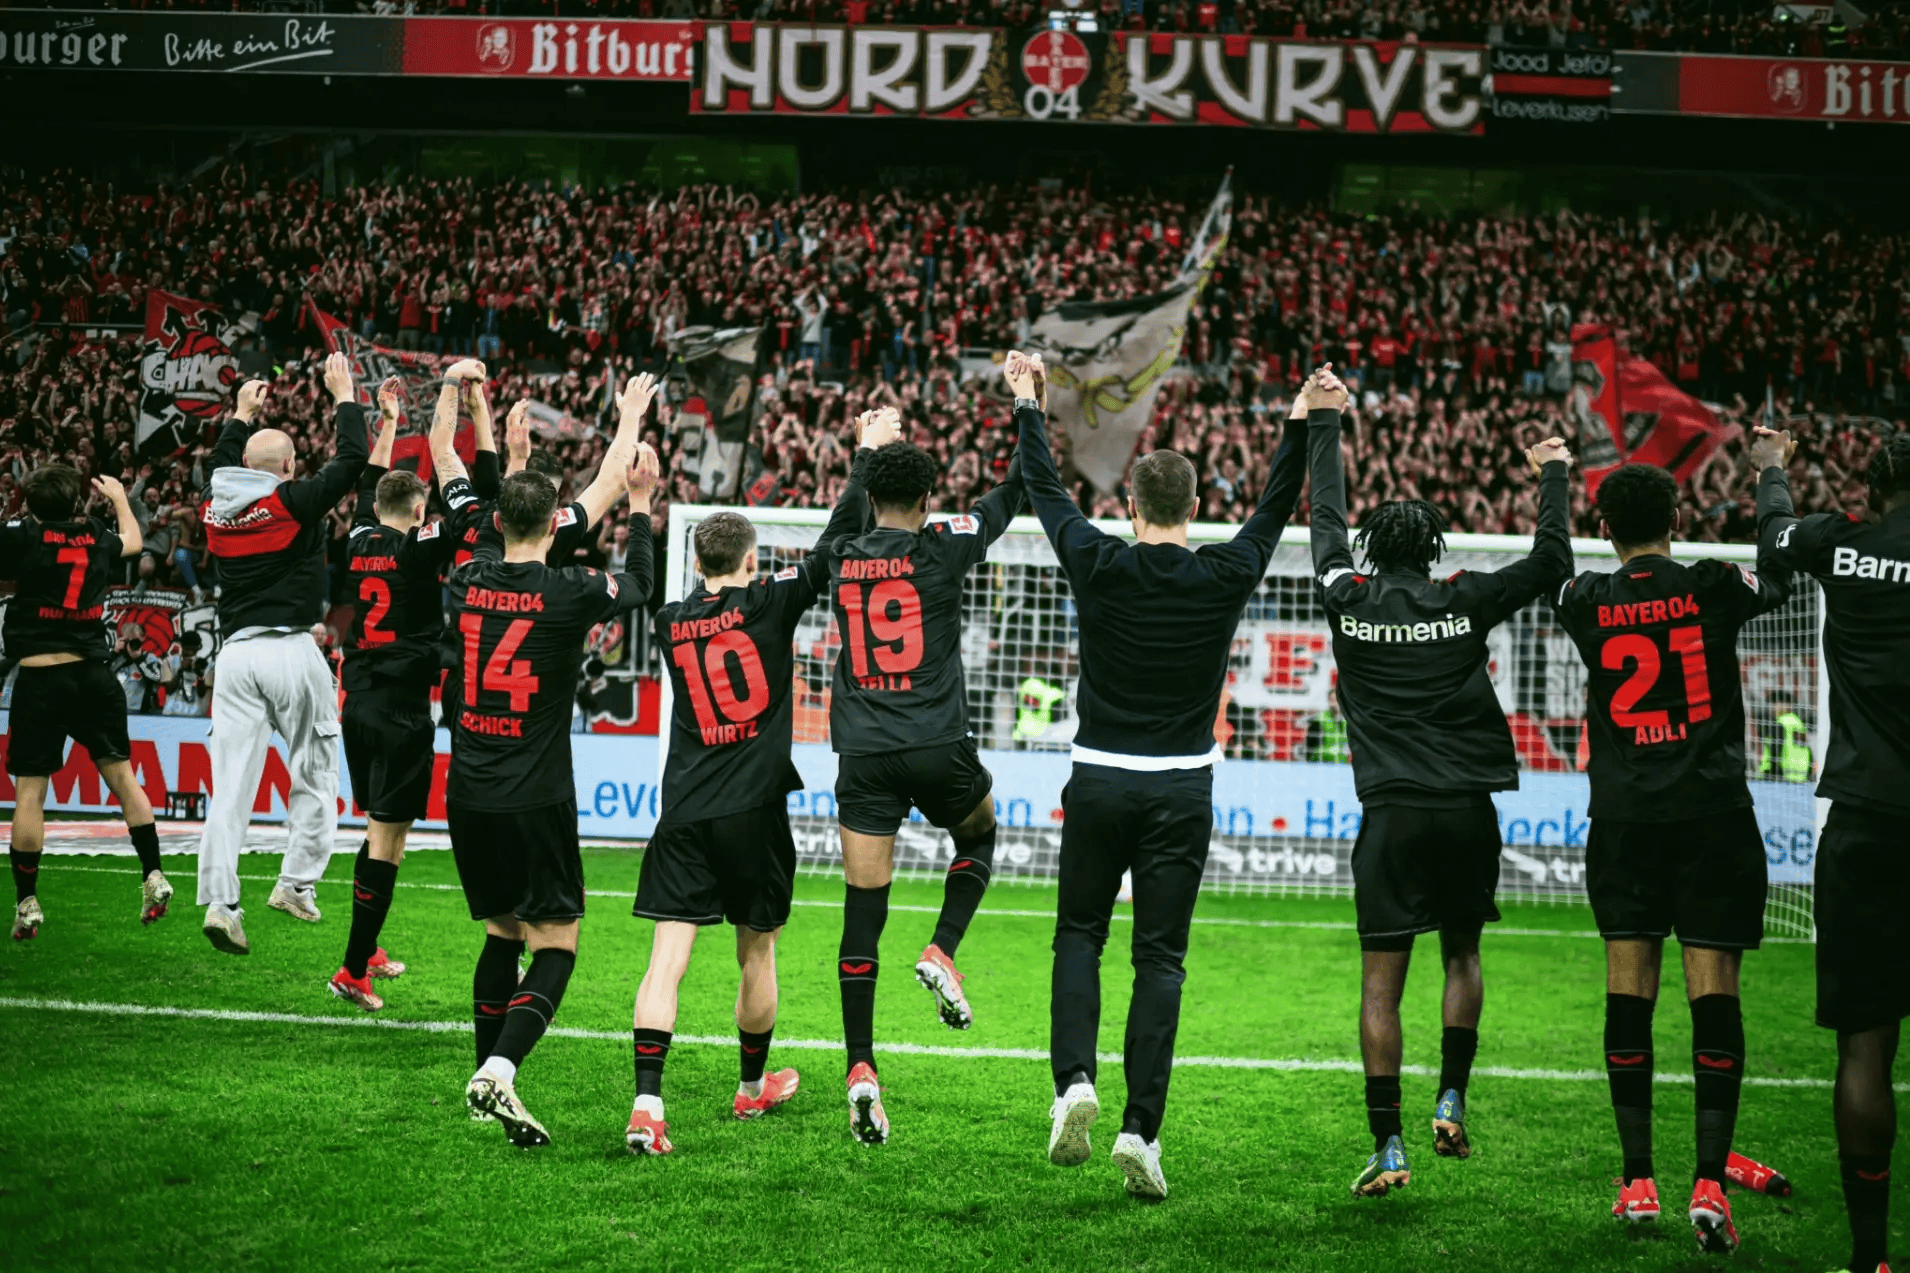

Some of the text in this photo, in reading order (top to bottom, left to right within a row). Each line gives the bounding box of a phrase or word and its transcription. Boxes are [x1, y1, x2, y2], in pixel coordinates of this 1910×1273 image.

[164, 33, 225, 66] Bitte
[233, 34, 279, 55] ein
[1024, 84, 1081, 120] 04
[1125, 37, 1483, 130] KURVE
[1821, 64, 1910, 117] Bit
[57, 547, 90, 610] 7
[359, 576, 396, 642] 2
[838, 579, 924, 677] 19
[1340, 613, 1472, 643] Barmenia
[459, 612, 540, 712] 14
[672, 629, 770, 723] 10
[1601, 624, 1712, 724] 21
[460, 711, 523, 737] SCHICK
[700, 720, 760, 746] WIRTZ
[1634, 722, 1688, 746] ADLI
[1248, 847, 1338, 875] trive
